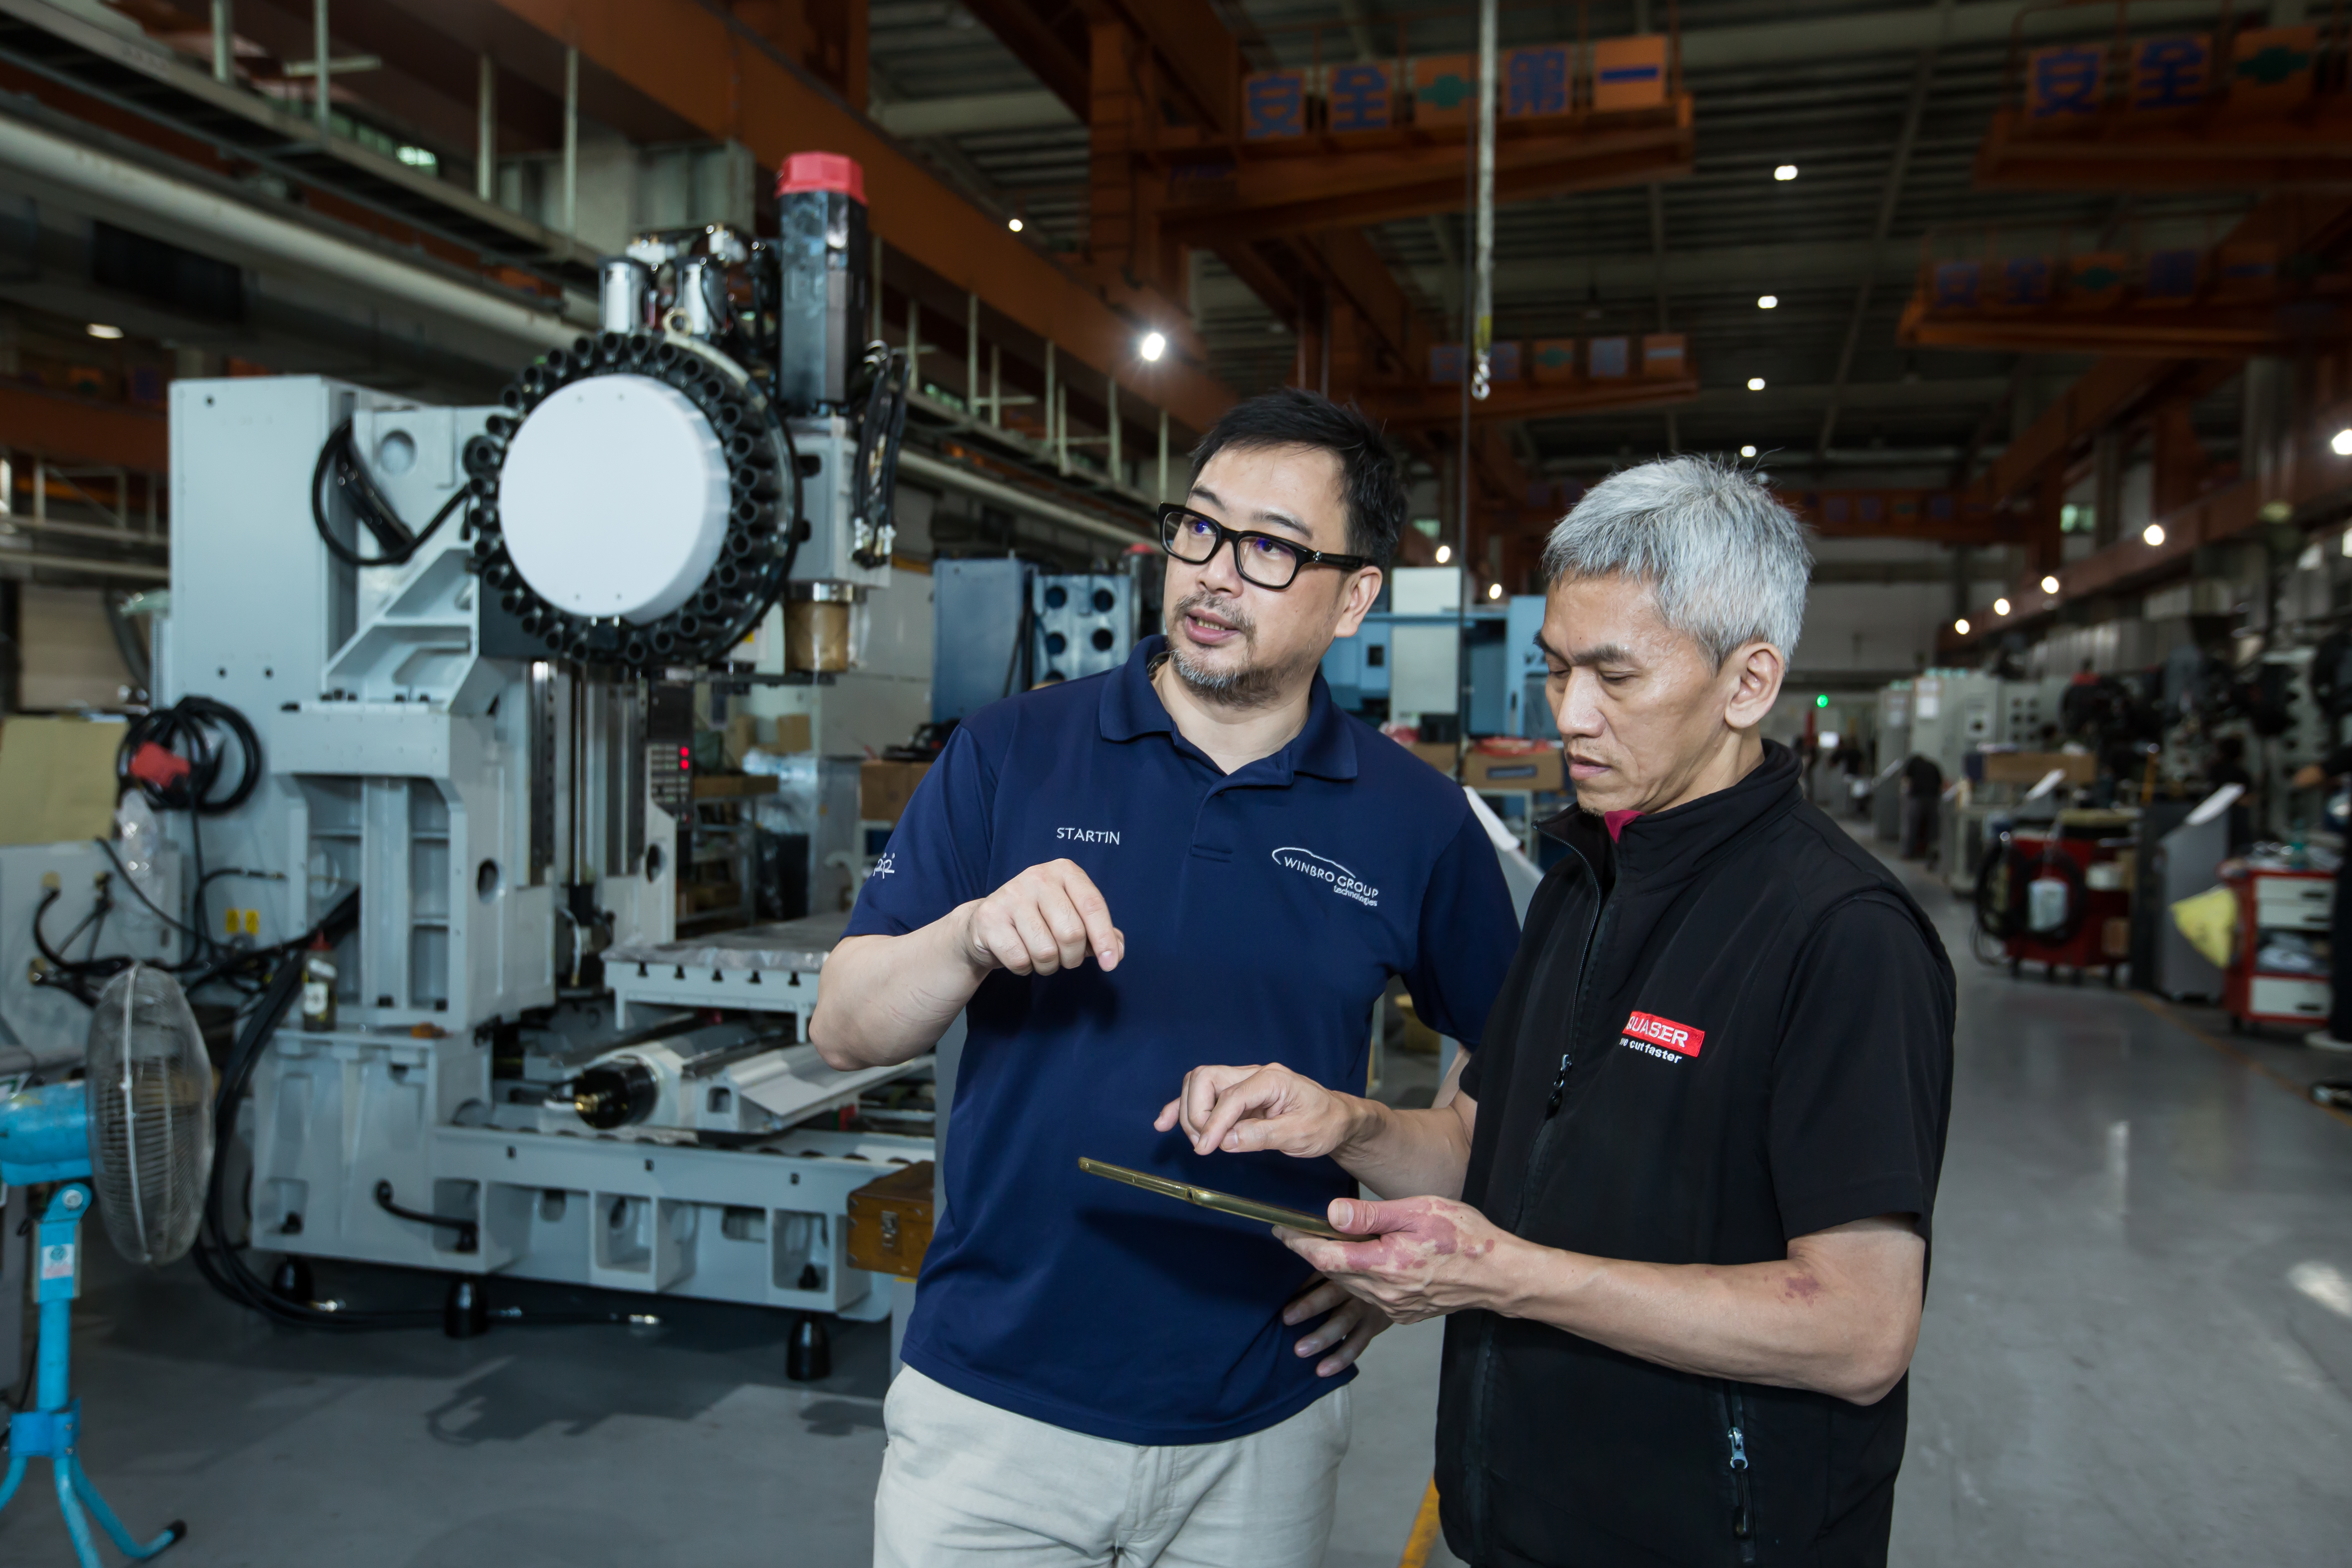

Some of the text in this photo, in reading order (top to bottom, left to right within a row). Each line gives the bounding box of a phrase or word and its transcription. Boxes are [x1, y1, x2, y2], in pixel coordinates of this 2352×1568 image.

[1056, 827, 1120, 845] STARTIN
[1284, 856, 1379, 898] WINBRO GROUP
[1334, 884, 1378, 906] technologies
[1626, 1016, 1688, 1048] QUASER
[1629, 1040, 1645, 1051] cut
[1645, 1043, 1683, 1063] faster
